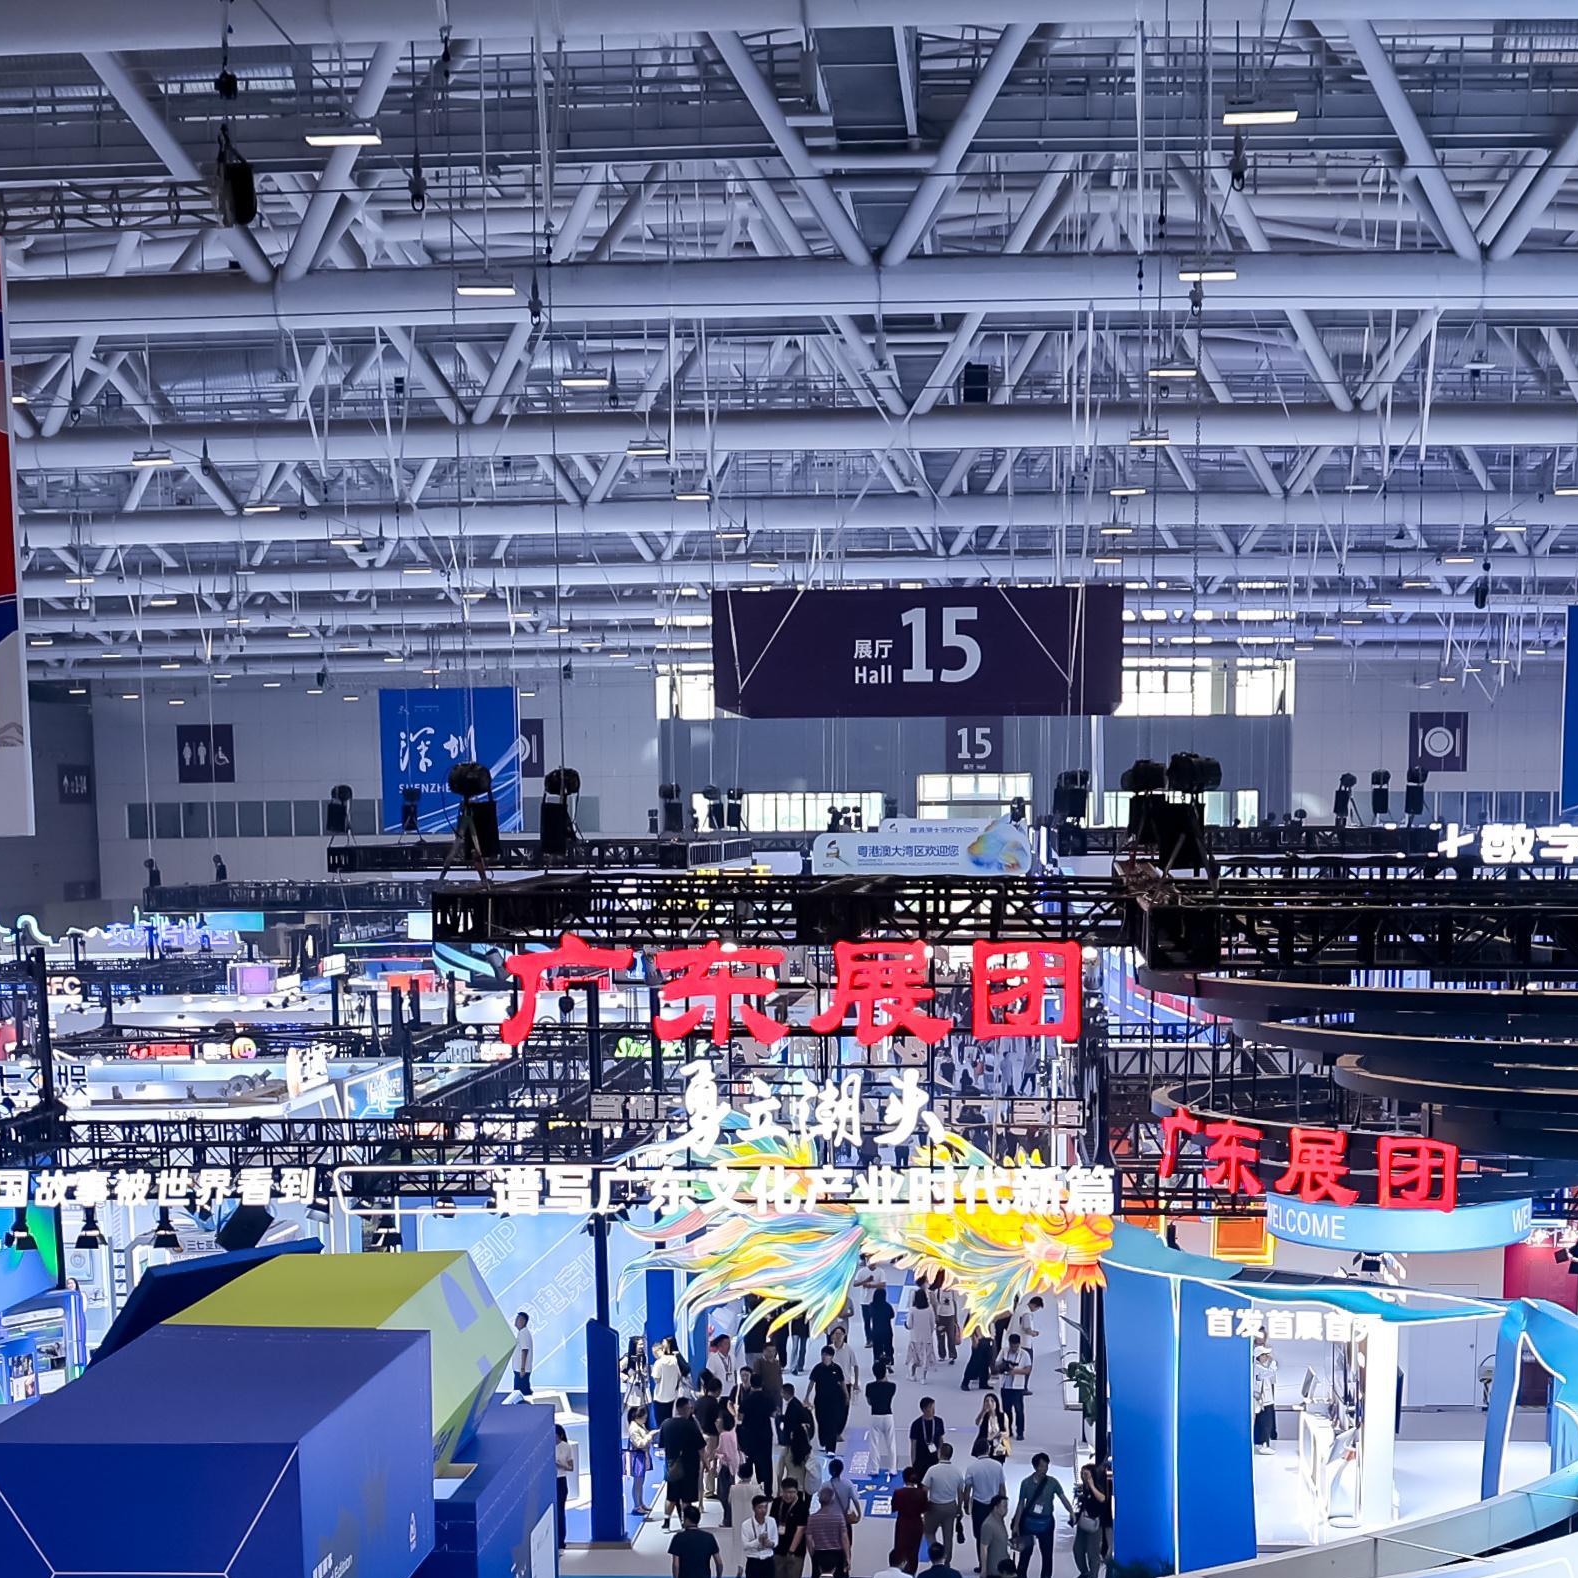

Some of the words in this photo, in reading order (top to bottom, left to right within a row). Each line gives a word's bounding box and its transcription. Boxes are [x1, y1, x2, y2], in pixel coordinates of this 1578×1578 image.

[853, 638, 893, 660] 展厅
[901, 606, 982, 683] 15
[854, 664, 893, 684] Hall
[956, 727, 993, 759] 15
[399, 784, 451, 796] SHENZHE
[856, 843, 960, 859] 粤港澳大湾区欢迎您
[500, 932, 1081, 1047] 广东展团
[1160, 1107, 1459, 1213] 广东展团
[494, 1165, 1115, 1217] 谱写广东文化产业时代新篇
